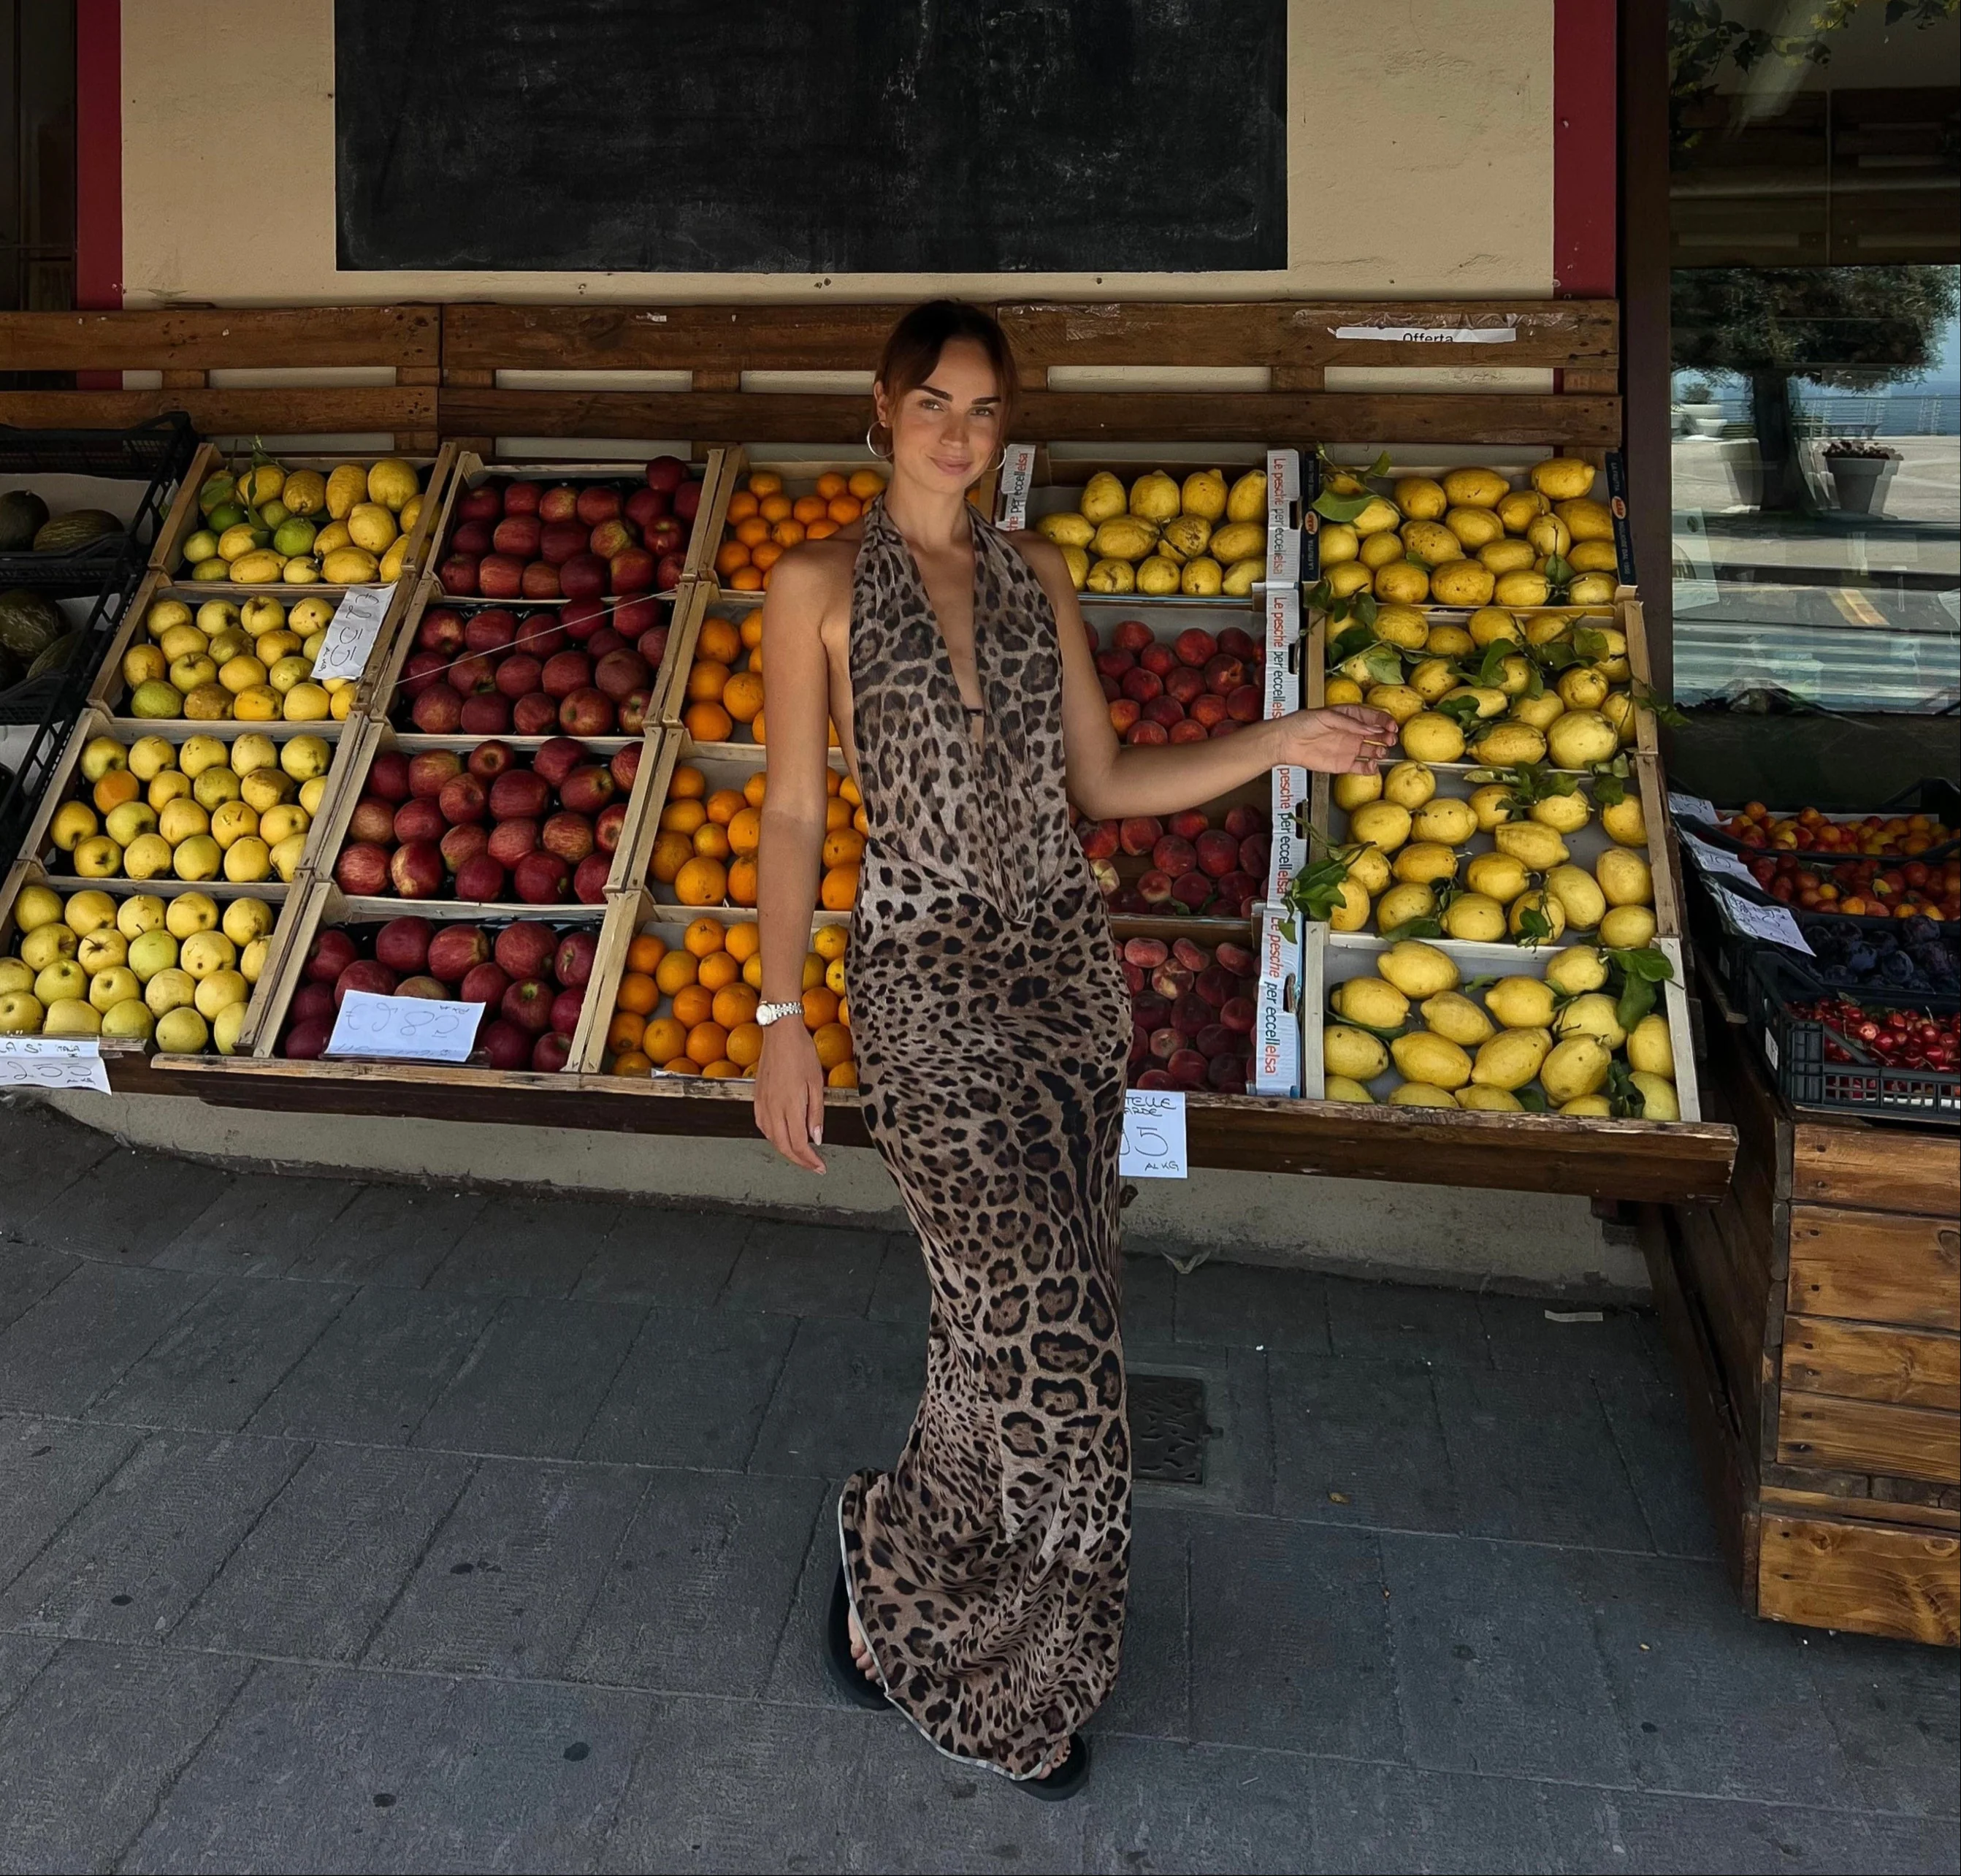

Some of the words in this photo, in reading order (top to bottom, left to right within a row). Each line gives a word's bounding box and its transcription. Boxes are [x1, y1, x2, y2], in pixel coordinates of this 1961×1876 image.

[1402, 332, 1454, 342] Offerta
[1013, 452, 1028, 496] eccellelsa
[1274, 457, 1286, 470] Le
[1271, 472, 1287, 506] pesche
[1010, 497, 1022, 513] per
[1271, 508, 1285, 525] per
[1274, 597, 1287, 609] Le
[1271, 611, 1287, 647] pesche
[1273, 651, 1284, 668] per
[1272, 670, 1286, 720] eccellels
[1277, 768, 1293, 809] pesche
[1277, 812, 1293, 833] per
[1266, 933, 1283, 978] pesche
[1264, 981, 1280, 1005] per
[1264, 1007, 1280, 1074] eccellelsa
[1144, 1162, 1158, 1171] AL
[1162, 1160, 1180, 1172] KG
